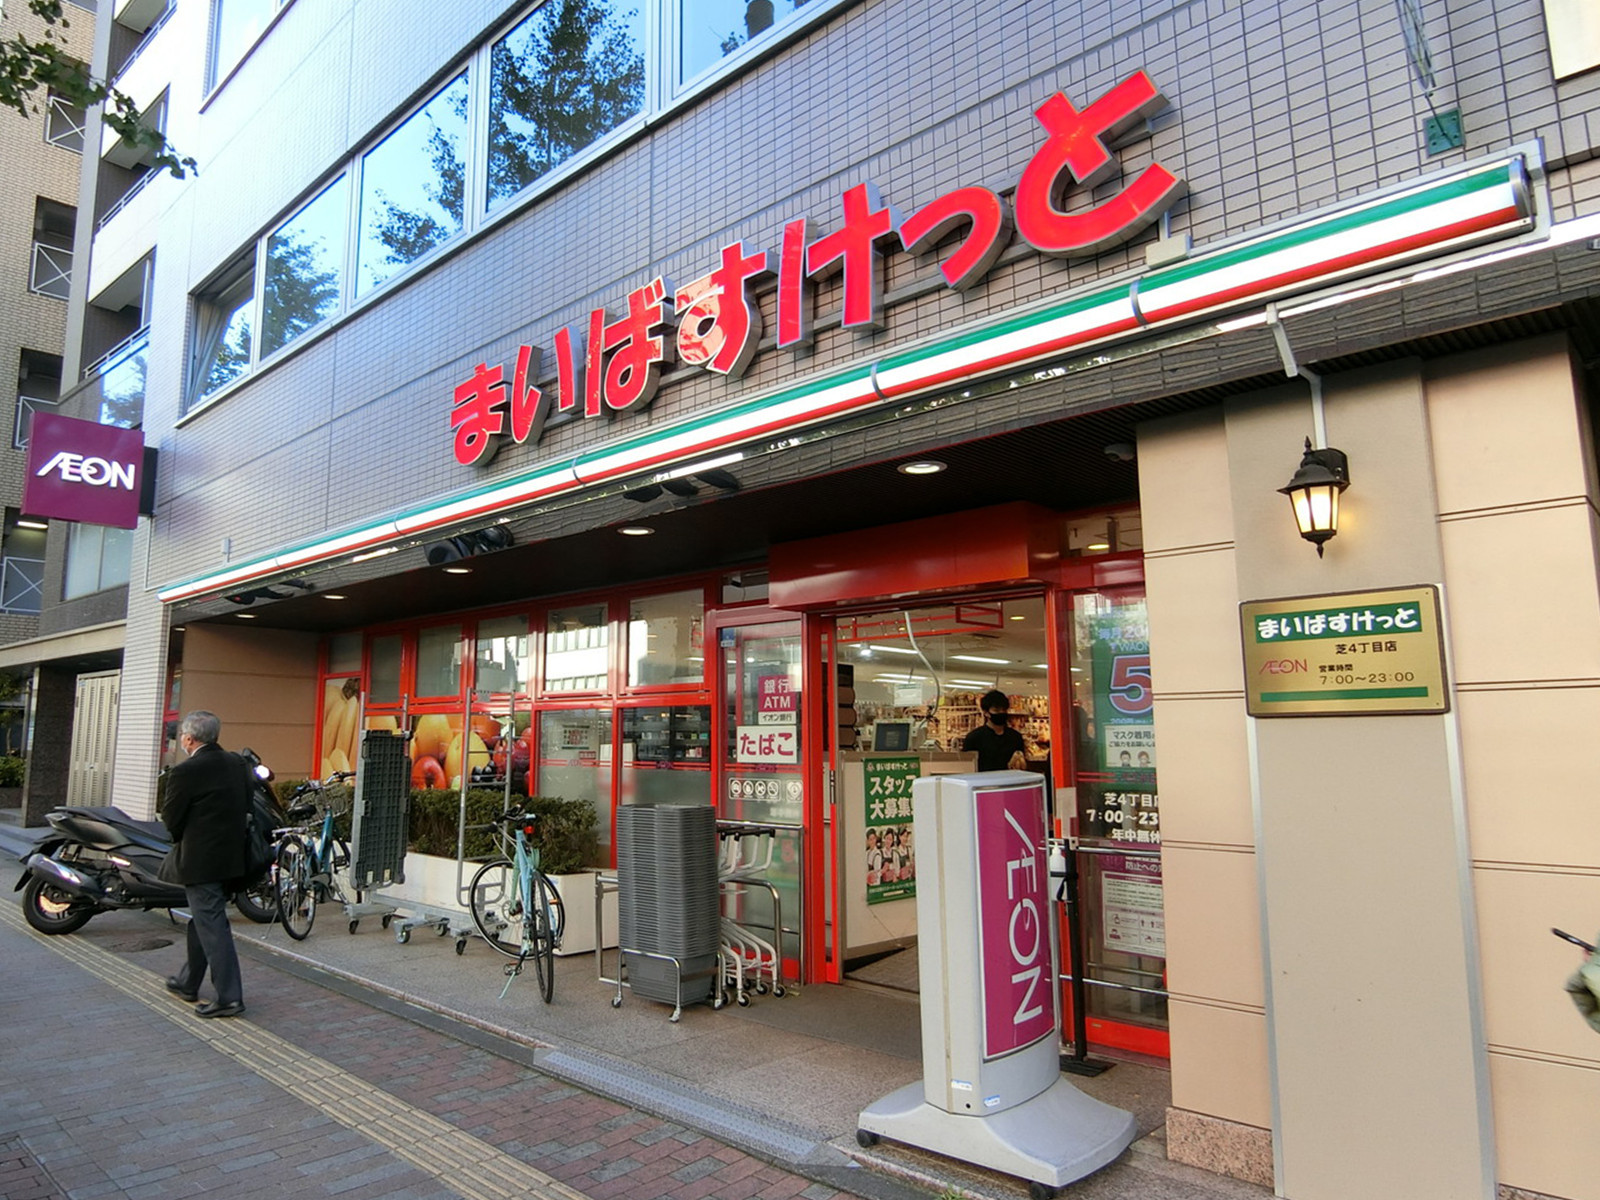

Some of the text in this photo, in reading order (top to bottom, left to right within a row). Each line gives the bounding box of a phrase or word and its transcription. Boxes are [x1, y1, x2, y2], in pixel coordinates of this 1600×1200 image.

[450, 68, 1184, 467] まいばすけっと
[1258, 607, 1419, 639] まいばすけっと
[1335, 641, 1398, 655] 芝4丁目店
[1319, 664, 1354, 673] 営業時間
[764, 679, 789, 694] 銀行
[764, 696, 791, 709] ATM
[763, 713, 792, 721] イオン銀行
[740, 732, 794, 756] たばこ
[1112, 828, 1160, 844] 年中無休
[1125, 861, 1161, 873] 防止への
